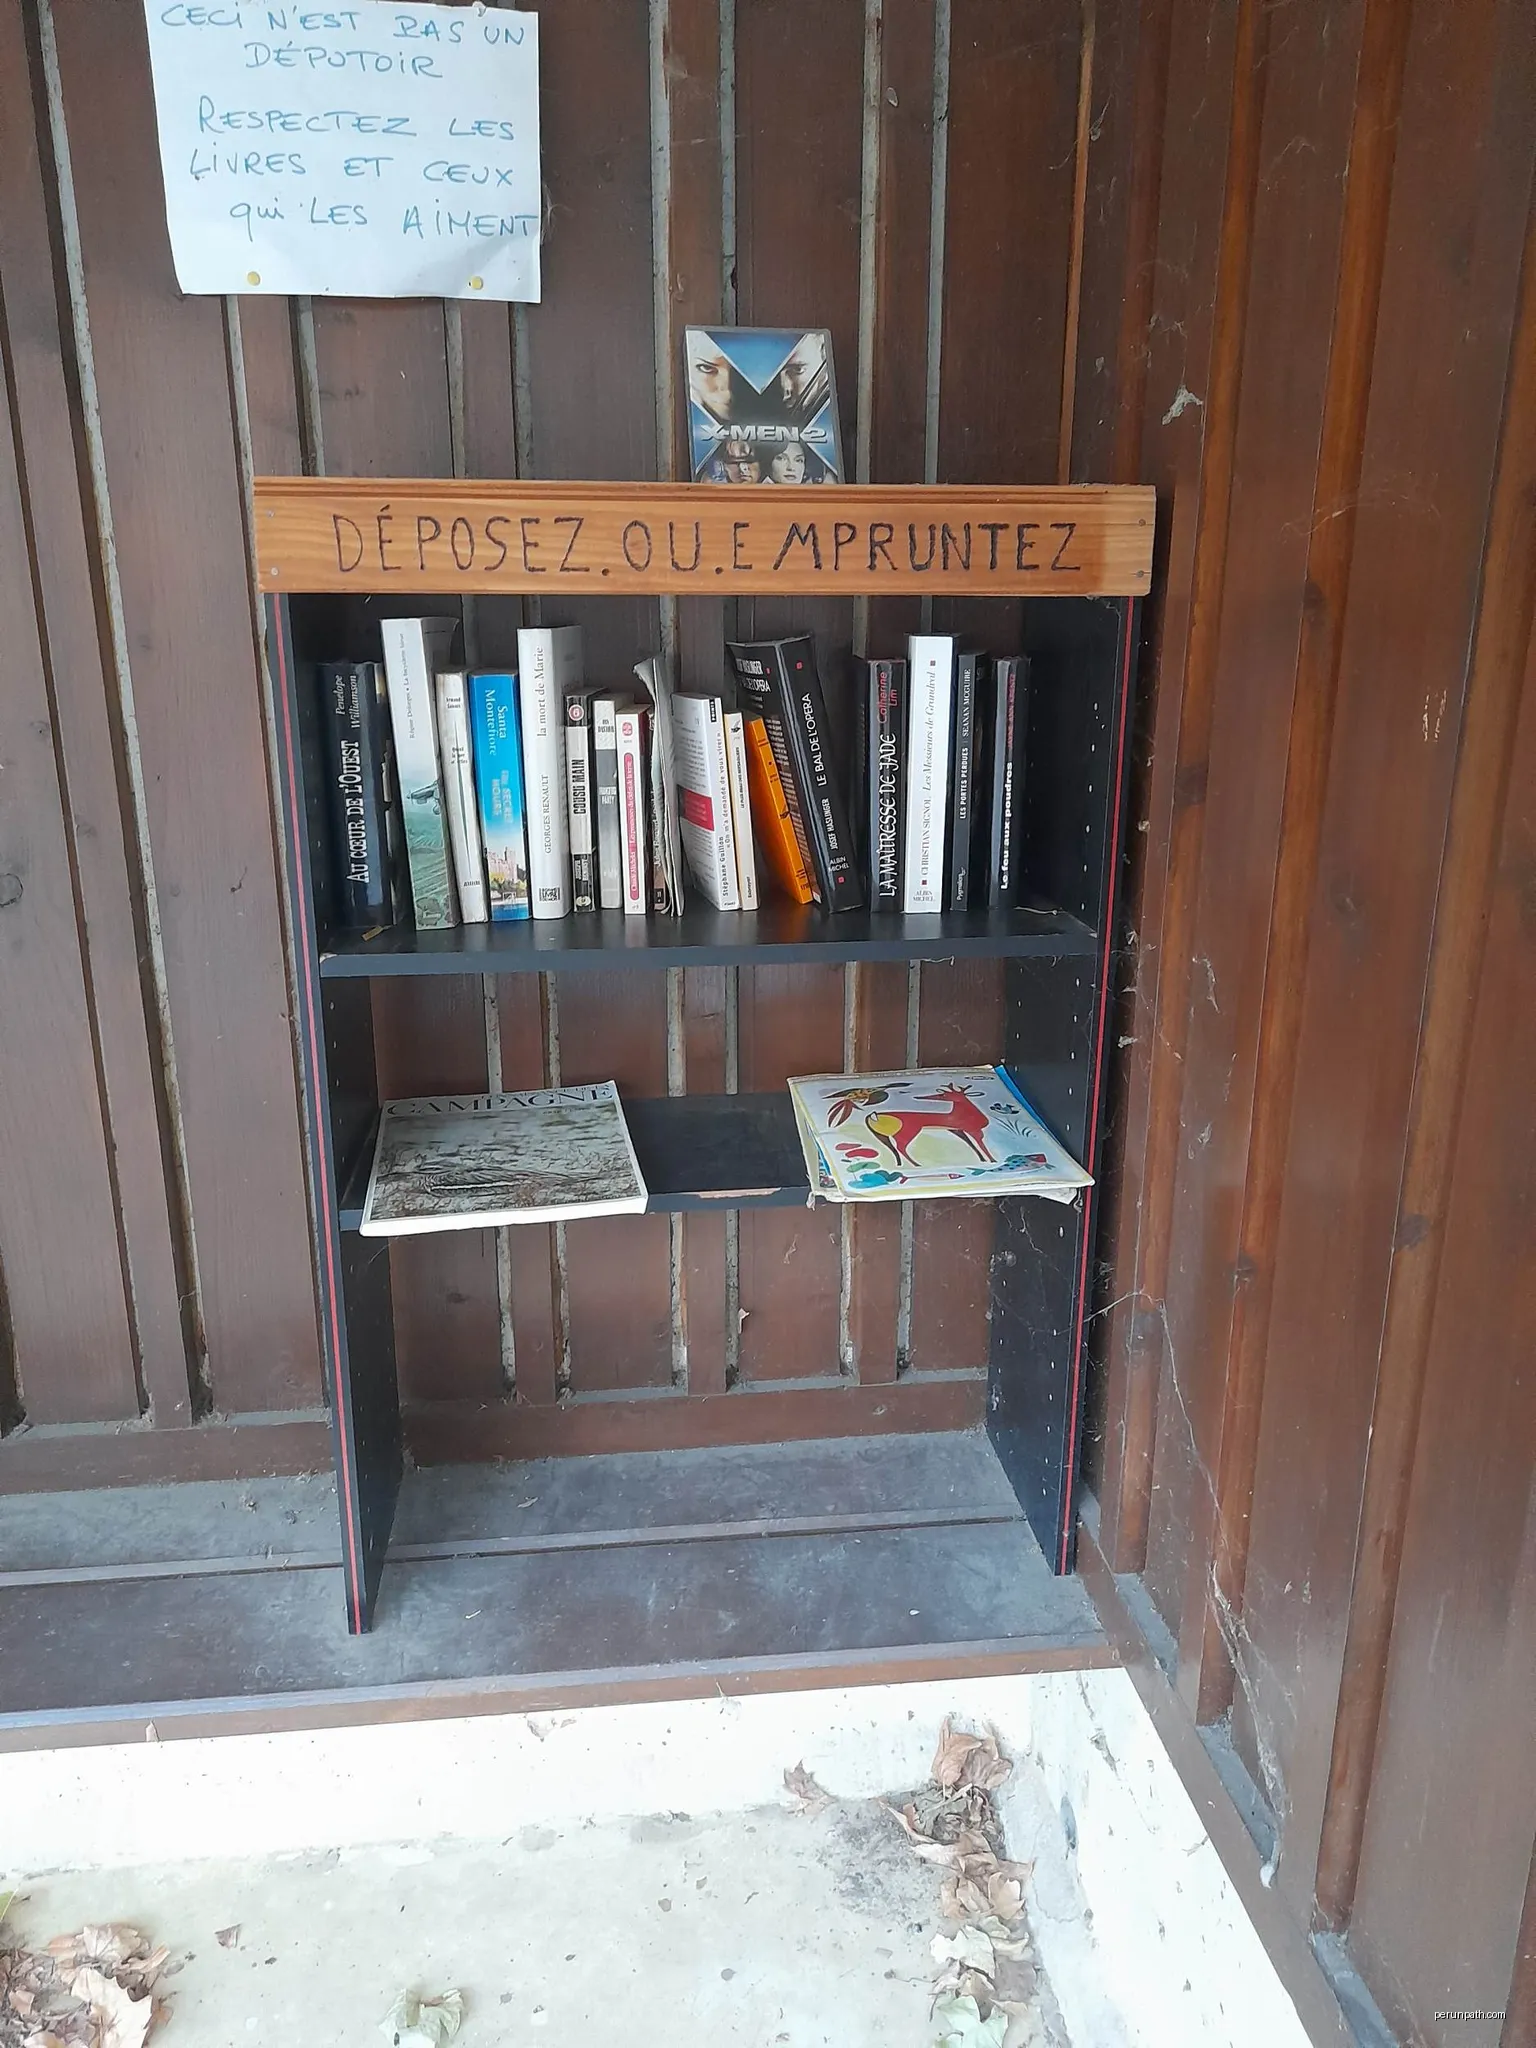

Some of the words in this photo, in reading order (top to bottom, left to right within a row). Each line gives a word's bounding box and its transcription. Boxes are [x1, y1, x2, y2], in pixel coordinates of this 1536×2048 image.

[267, 5, 361, 31] N'EST
[484, 26, 524, 45] UN
[200, 95, 417, 137] RESPECTEZ
[448, 118, 515, 141] LES
[344, 157, 393, 178] ET
[423, 161, 513, 186] CEUX
[230, 198, 284, 242] qui
[311, 197, 368, 226] LES
[733, 521, 1081, 573] EMPRUNTEZ
[533, 646, 546, 679] Marie
[334, 674, 347, 716] Penelope
[534, 682, 546, 696] de
[876, 671, 888, 724] Catherine
[962, 668, 972, 705] MCGUIRE
[350, 674, 362, 729] Williamson
[535, 698, 547, 725] mort
[485, 689, 497, 756] Montefiore
[497, 705, 508, 739] Santa
[535, 727, 547, 737] la
[924, 717, 934, 729] de
[962, 706, 971, 737] SEANAN
[809, 737, 821, 752] DE
[879, 733, 899, 771] JADE
[923, 730, 934, 774] Messieurs
[337, 740, 363, 794] L'OUEST
[571, 758, 586, 783] MAIN
[717, 757, 725, 774] vous
[812, 752, 825, 772] BAL
[960, 747, 969, 778] PERDUES
[540, 774, 551, 814] RENAULT
[816, 773, 828, 787] LE
[879, 774, 897, 795] DE
[922, 775, 932, 792] Les
[959, 779, 969, 805] PORTES
[1003, 762, 1014, 818] poudres
[345, 797, 365, 816] DE
[572, 785, 587, 814] COUSU
[922, 796, 932, 829] SIGNOL
[959, 807, 968, 819] LES
[821, 797, 835, 832] HASLINGER
[542, 815, 553, 854] GEORGES
[828, 832, 838, 850] JOSEF
[876, 797, 898, 876] MAÎTRESSE
[1002, 821, 1011, 847] aux
[829, 856, 846, 865] ALBIN
[920, 829, 931, 876] CHRISTIAN
[1001, 850, 1010, 872] feu
[346, 863, 370, 884] AU
[827, 863, 850, 872] MICHEL
[1000, 874, 1009, 889] Le
[879, 879, 898, 896] LA
[387, 1087, 614, 1116] CAMPAGNE
